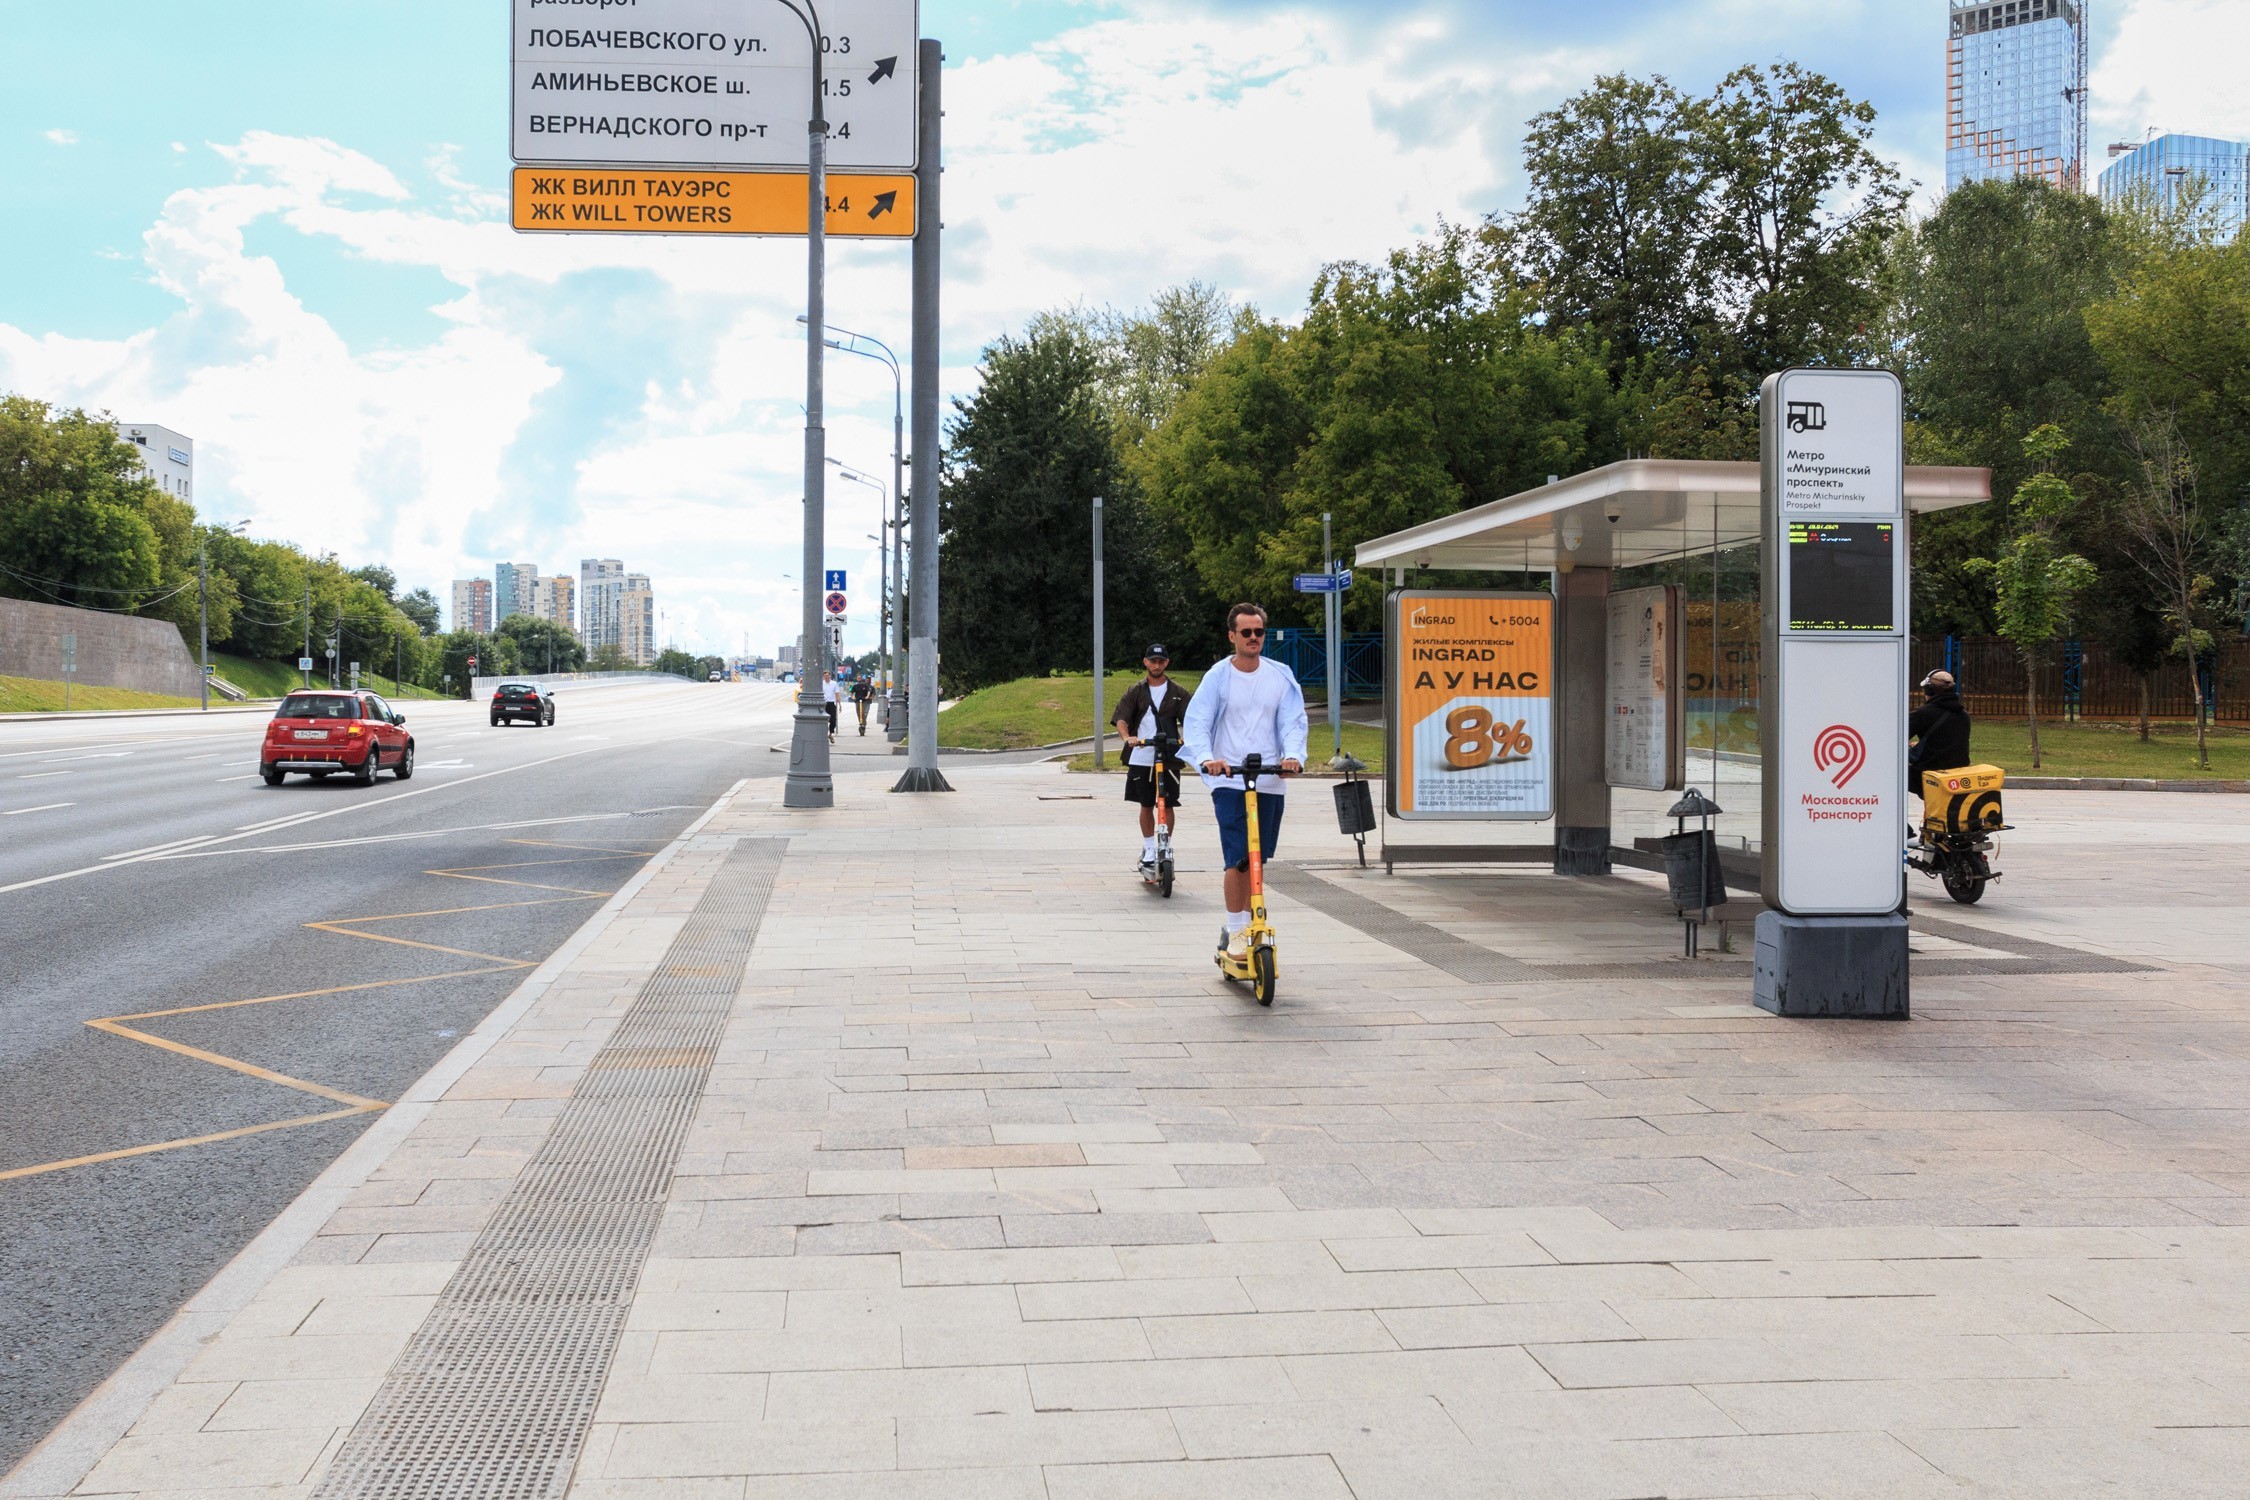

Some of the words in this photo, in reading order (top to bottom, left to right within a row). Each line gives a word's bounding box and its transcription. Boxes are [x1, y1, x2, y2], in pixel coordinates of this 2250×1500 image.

[528, 29, 727, 52] ЛОБАЧЕВСКОГО
[733, 38, 767, 56] ул.
[820, 36, 851, 54] 0.3
[531, 72, 718, 94] АМИНЬЕВСКОЕ
[726, 81, 751, 95] ш.
[821, 78, 851, 97] 1.5
[529, 115, 713, 138] ВЕРНАДСКОГО
[720, 124, 768, 142] пр-т
[531, 178, 565, 195] ЖК
[573, 179, 635, 197] ВИЛЛ
[643, 180, 731, 198] ТАУЭРС
[531, 203, 565, 220] ЖК
[572, 204, 627, 222] WILL
[634, 205, 732, 223] TOWERS
[1787, 449, 1825, 462] Метро
[1786, 463, 1871, 476] «Мичуринский
[1786, 478, 1844, 488] проспект»
[1786, 491, 1811, 500] Metro
[1812, 492, 1866, 502] Michurinskiy
[1786, 500, 1821, 510] Prospekt
[1414, 616, 1455, 625] INGRAD
[1412, 648, 1496, 662] INGRAD
[1414, 671, 1436, 690] А
[1444, 671, 1465, 690] У
[1473, 672, 1539, 691] НАС
[1444, 705, 1533, 768] 8%
[1801, 793, 1879, 805] Московский
[1807, 808, 1873, 823] Транспорт
